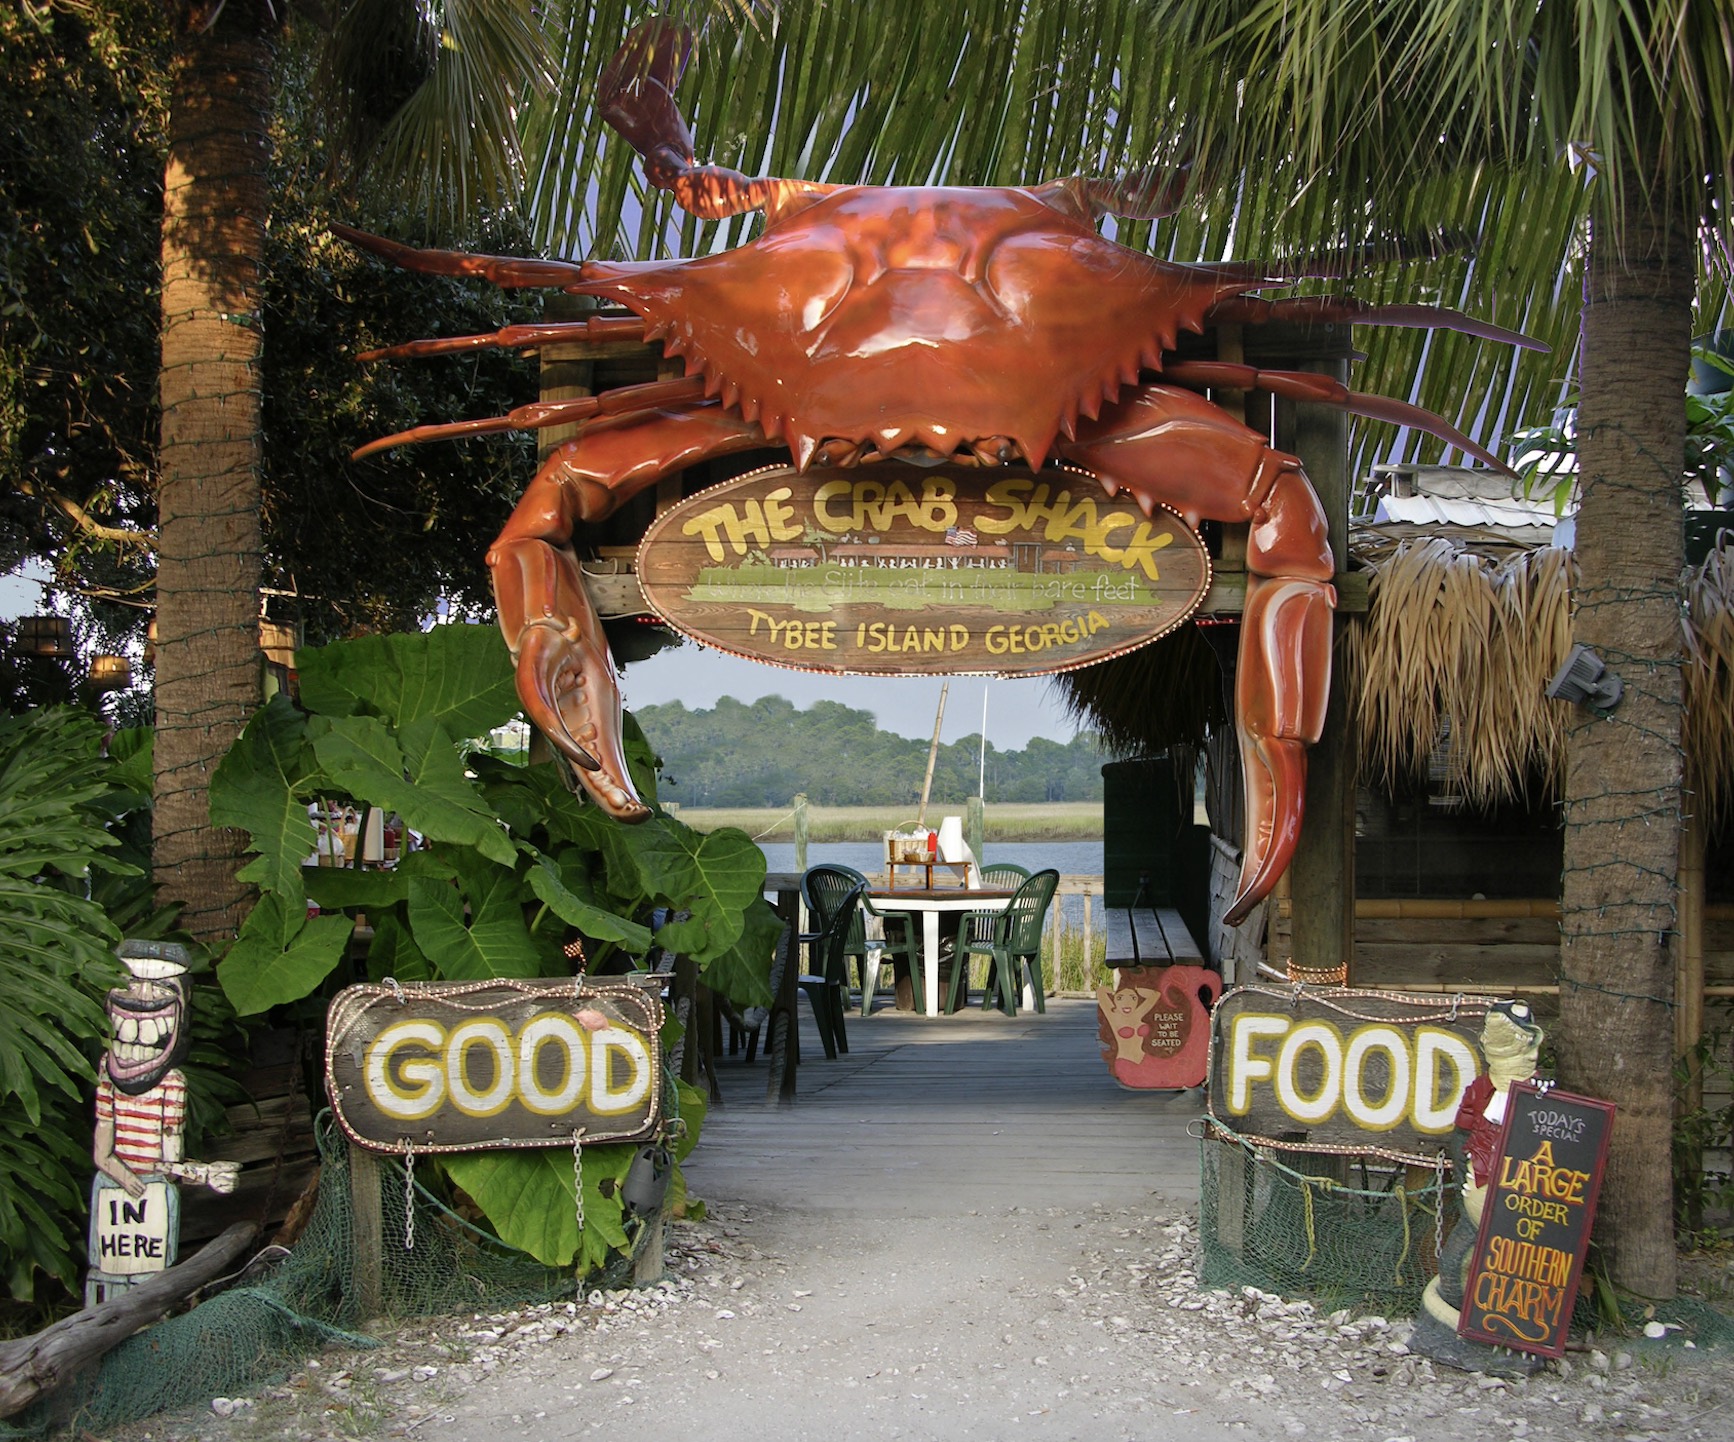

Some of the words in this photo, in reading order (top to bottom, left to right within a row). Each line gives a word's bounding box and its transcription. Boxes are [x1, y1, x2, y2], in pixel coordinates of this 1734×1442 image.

[682, 486, 804, 561] THE
[814, 477, 959, 535] CRAB
[972, 478, 1174, 582] SHACK
[888, 571, 933, 599] eat
[942, 573, 964, 600] in
[1031, 574, 1086, 600] bare
[1090, 574, 1140, 602] feet
[747, 608, 838, 650] TYBEE
[856, 621, 970, 653] ISLAND
[985, 610, 1110, 655] GEORGIA
[1153, 1012, 1185, 1022] PLEASE
[1158, 1022, 1178, 1030] WAIT
[1151, 1038, 1182, 1047] SEATED
[1157, 1030, 1167, 1038] TO
[1169, 1030, 1179, 1038] BE
[364, 1011, 651, 1120] GOOD
[1228, 1012, 1482, 1134] FOOD
[1527, 1110, 1586, 1134] TODAY'S
[1532, 1125, 1580, 1143] SPECIAL
[1530, 1140, 1556, 1168] A
[1499, 1156, 1591, 1206] LARGE
[110, 1199, 147, 1226] IN
[1504, 1192, 1569, 1226] ORDER
[1516, 1217, 1545, 1242] OF
[101, 1233, 164, 1260] HERE
[1485, 1235, 1574, 1287] SOUTHERN
[1473, 1271, 1566, 1327] CHARM
